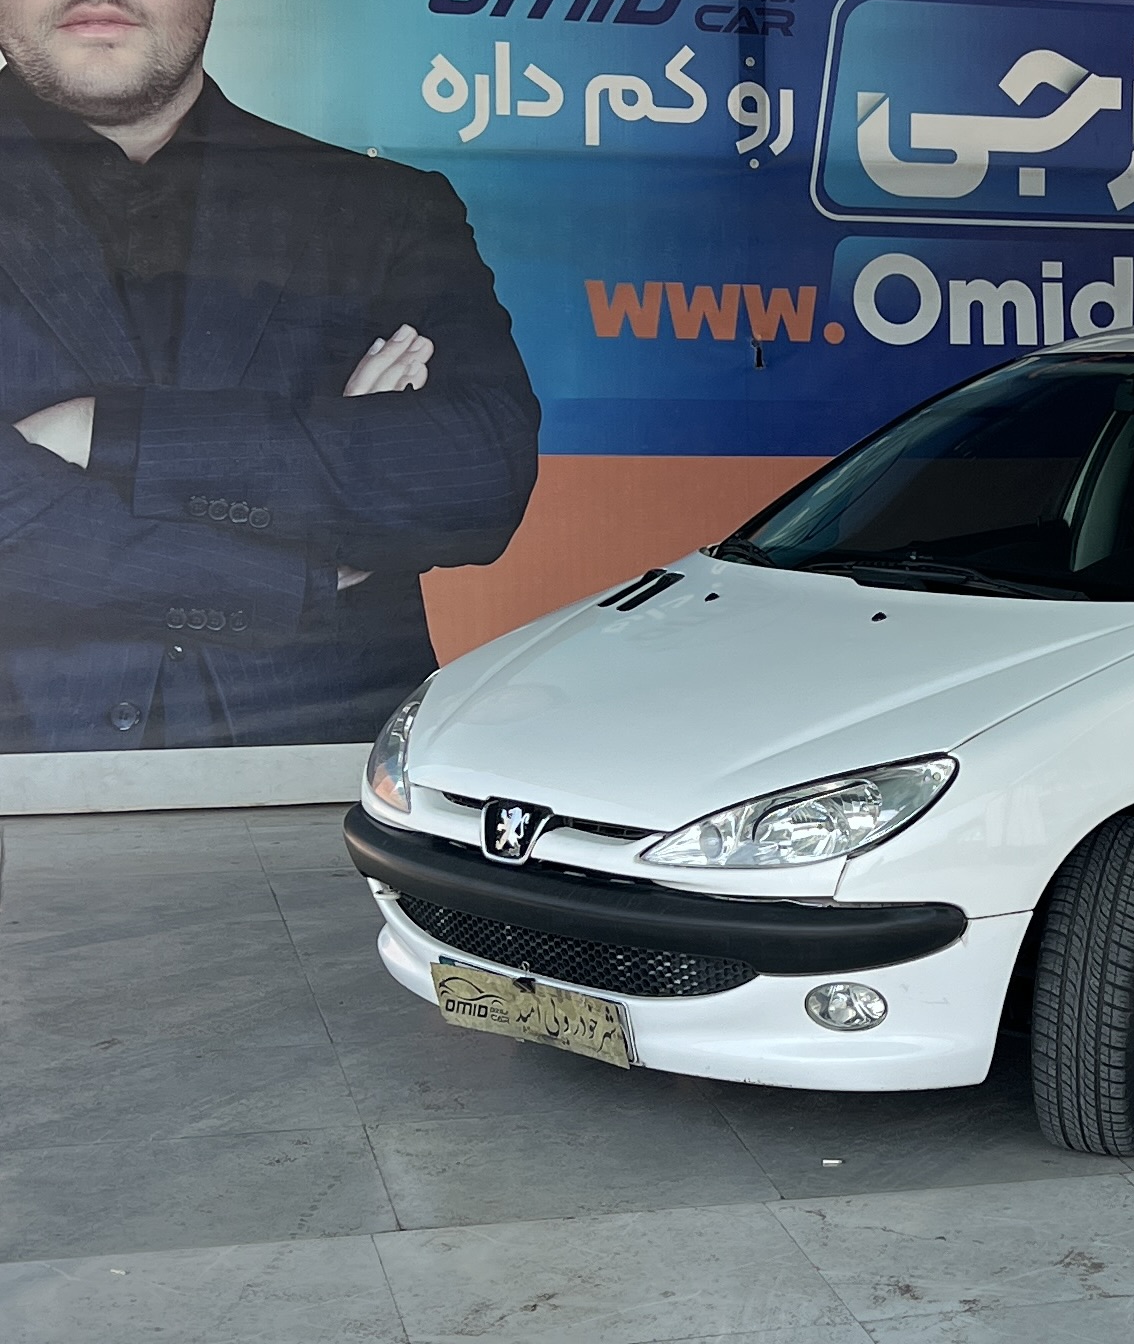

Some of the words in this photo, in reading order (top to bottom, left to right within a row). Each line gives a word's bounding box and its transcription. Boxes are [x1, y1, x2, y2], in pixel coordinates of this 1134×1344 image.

[694, 4, 796, 36] CAR
[421, 41, 565, 143] داره
[585, 45, 708, 147] کم
[727, 81, 794, 156] رو
[445, 998, 489, 1018] OMID
